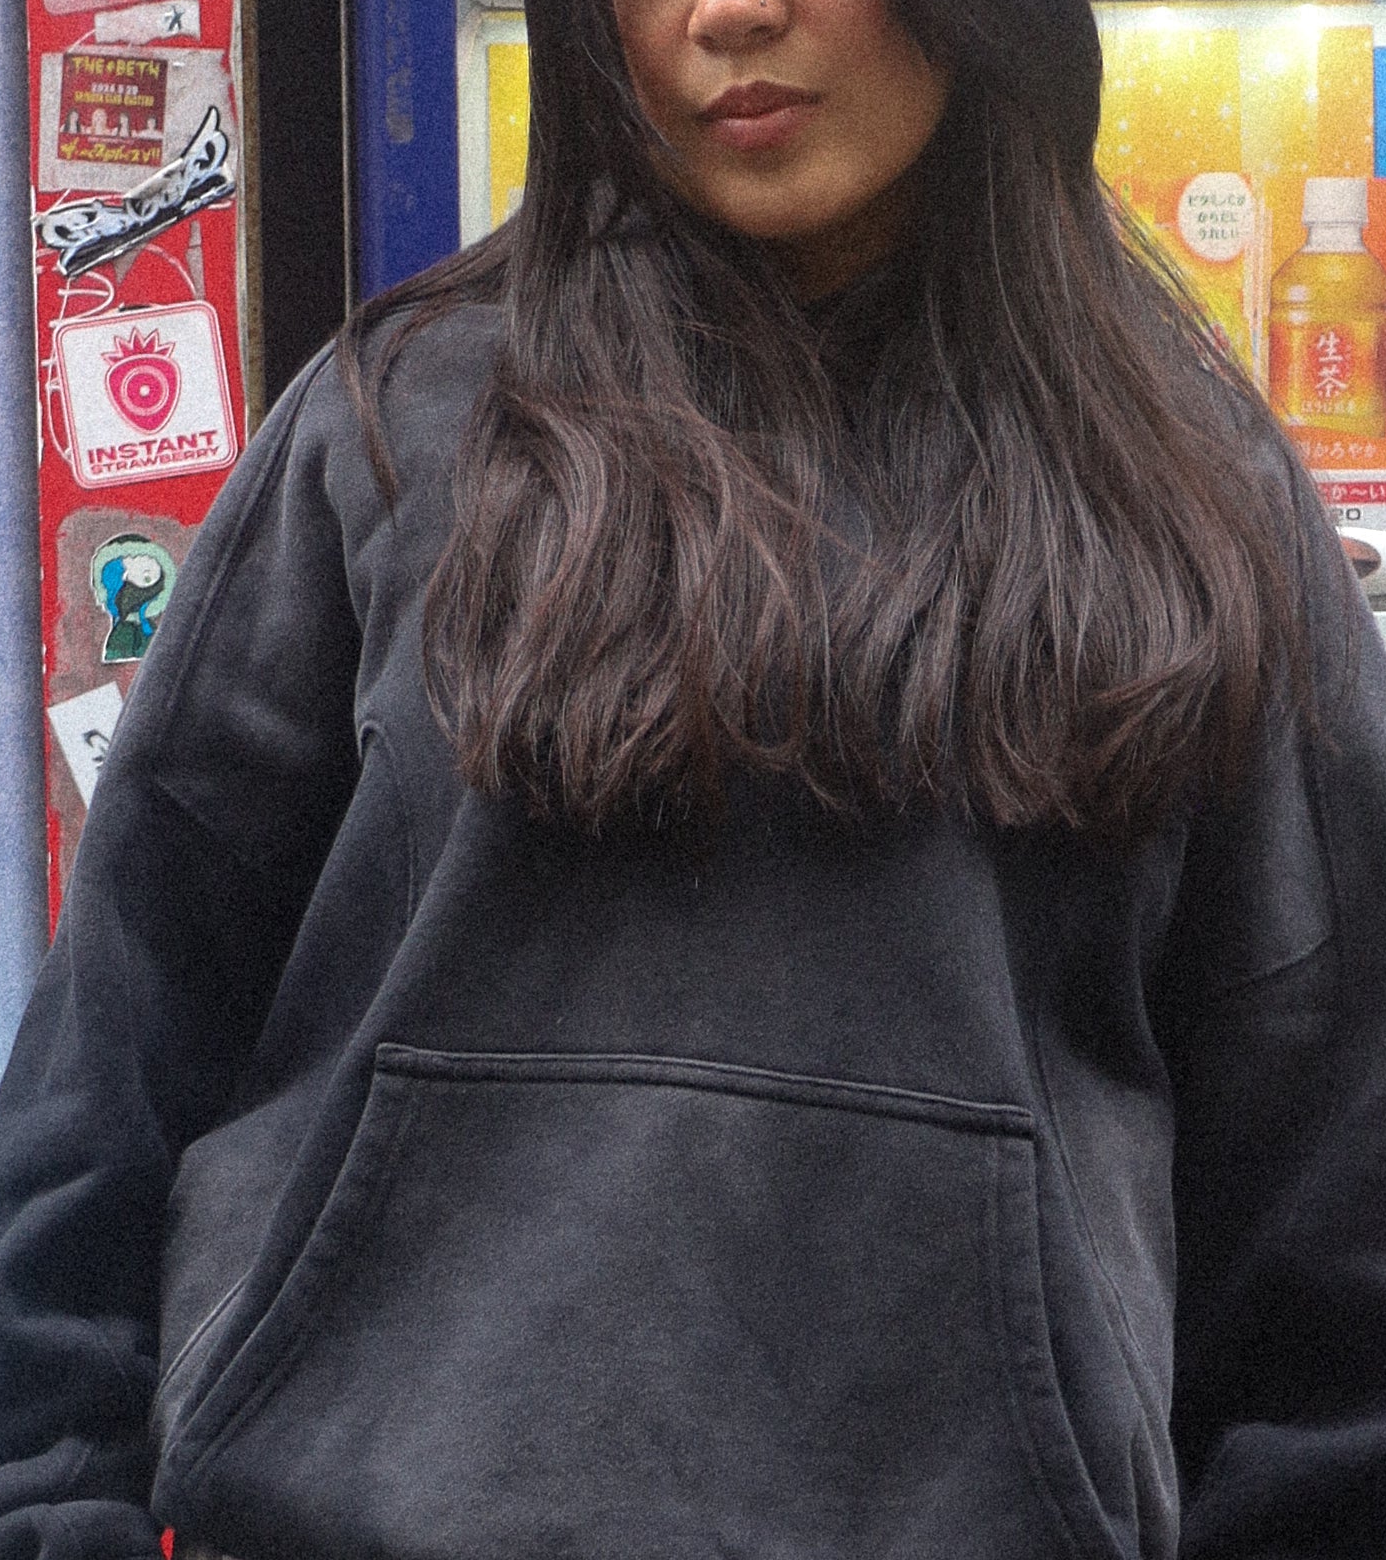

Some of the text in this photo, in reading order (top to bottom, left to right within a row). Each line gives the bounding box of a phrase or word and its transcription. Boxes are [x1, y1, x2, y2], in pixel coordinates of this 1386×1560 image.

[1315, 331, 1353, 398] 生茶
[87, 430, 220, 465] INSTANT
[89, 445, 221, 475] STRAWBERRY
